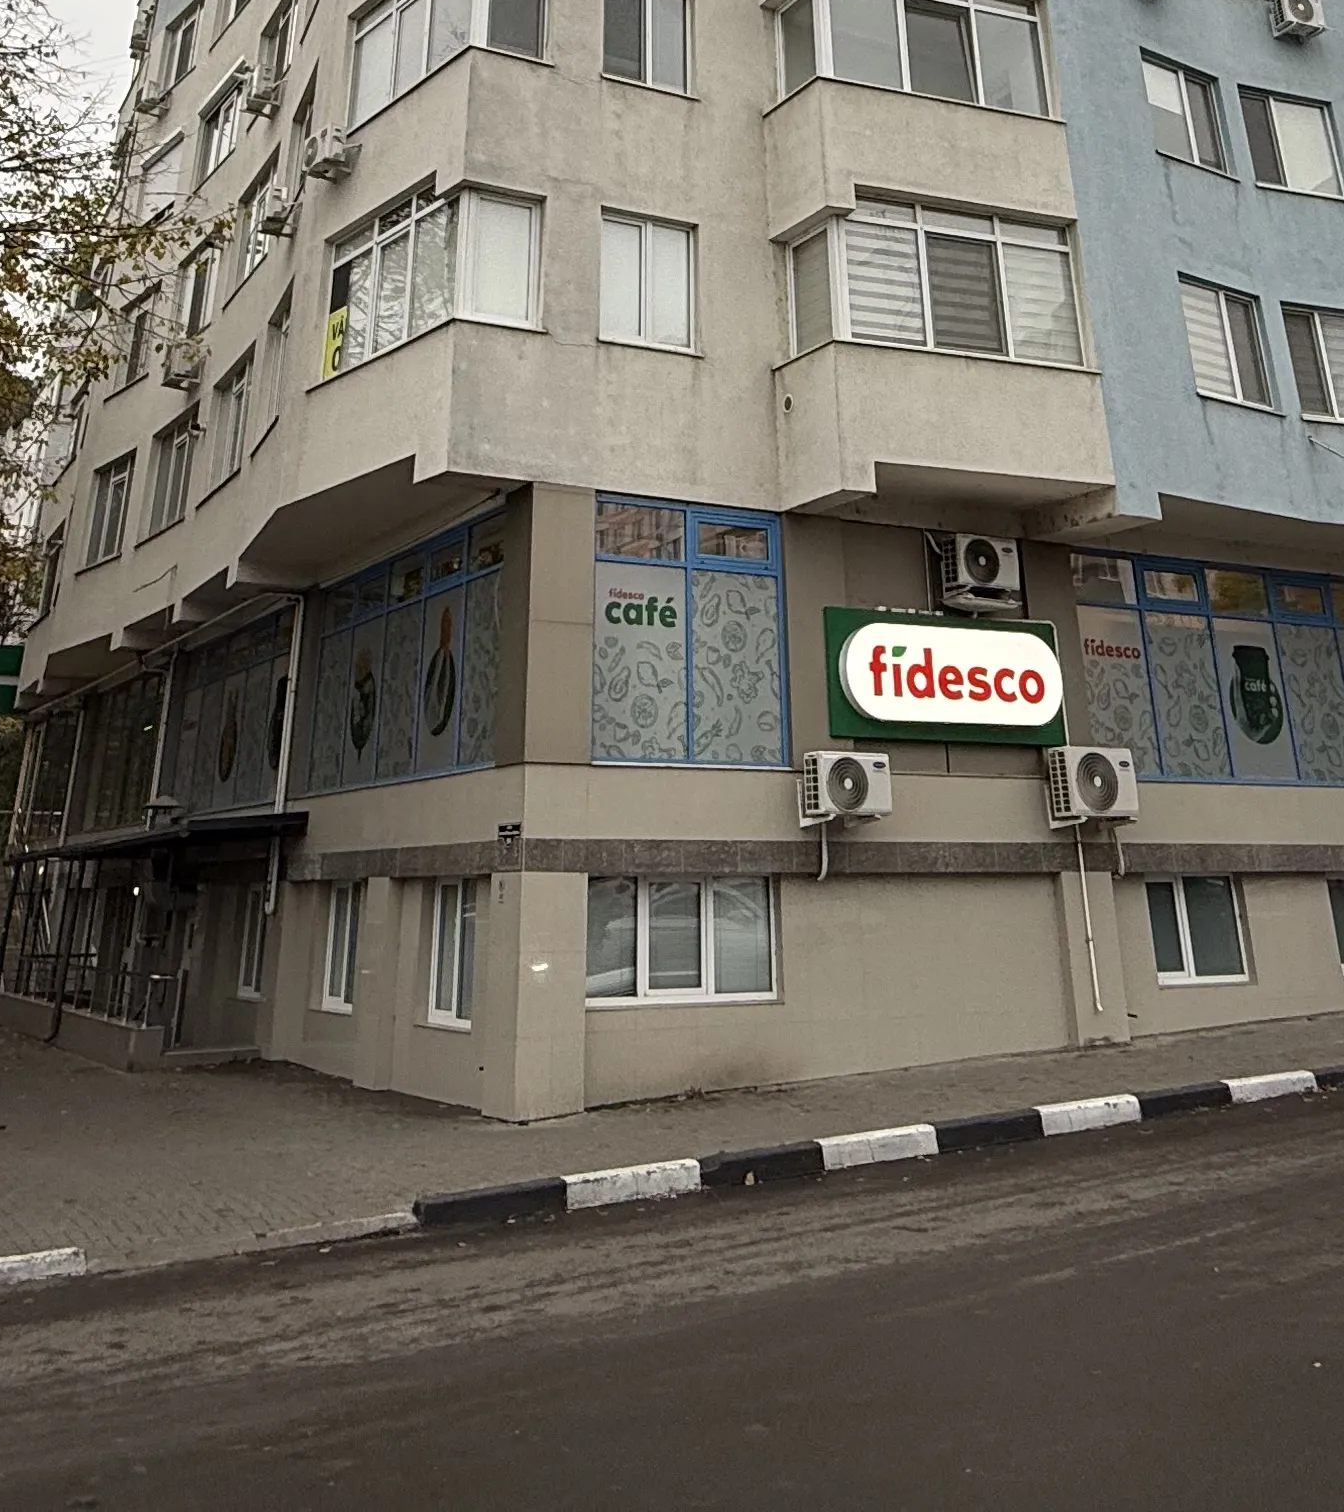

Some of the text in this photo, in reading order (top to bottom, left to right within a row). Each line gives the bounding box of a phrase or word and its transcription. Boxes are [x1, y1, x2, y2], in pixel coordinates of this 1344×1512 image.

[608, 588, 644, 601] fidesco
[605, 596, 677, 628] café
[1084, 638, 1141, 659] fidesco
[869, 645, 1045, 704] fidesco
